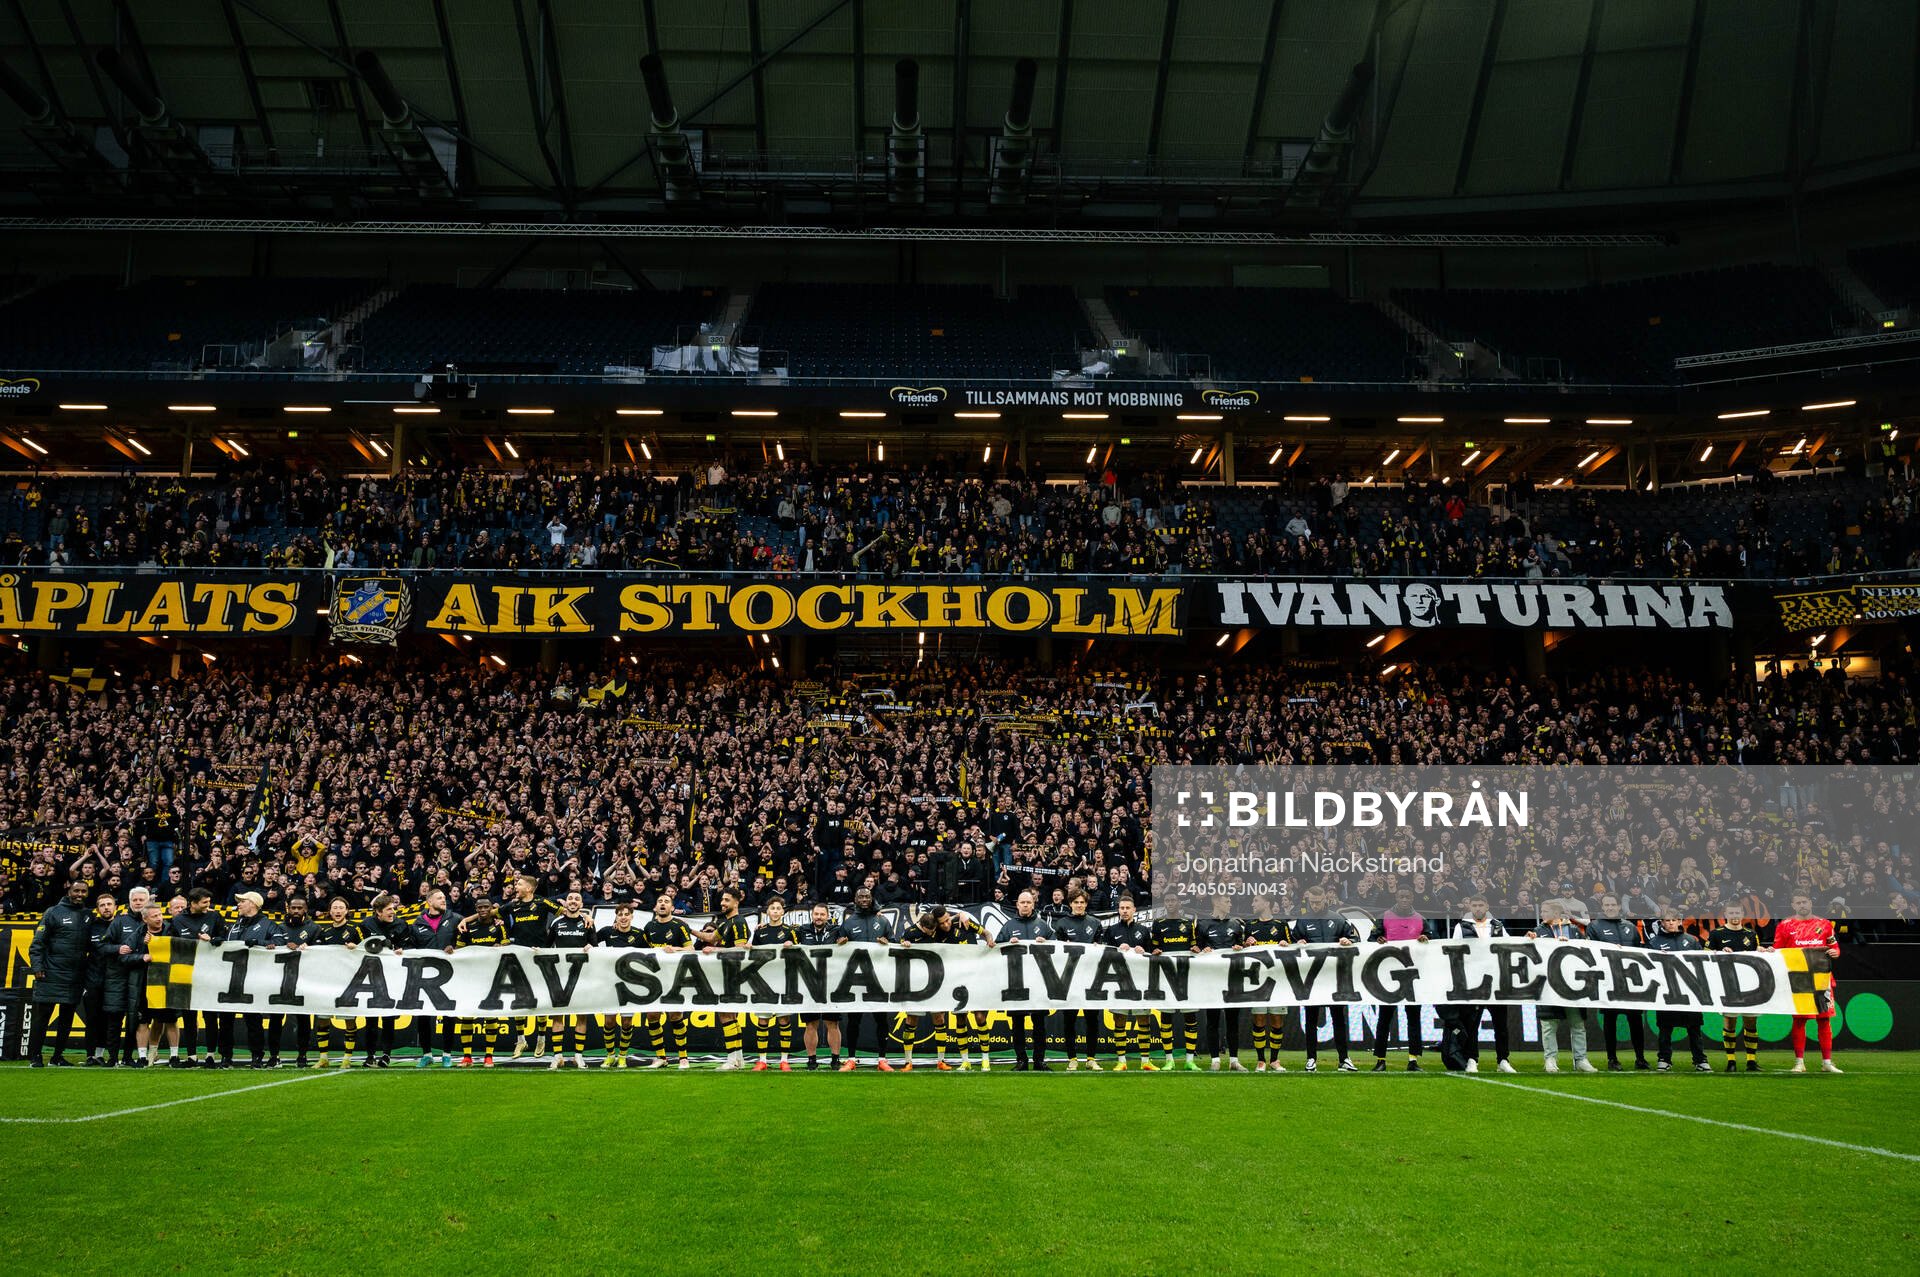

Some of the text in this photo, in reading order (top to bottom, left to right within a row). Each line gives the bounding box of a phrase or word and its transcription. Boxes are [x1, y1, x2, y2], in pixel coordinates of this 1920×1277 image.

[898, 391, 938, 402] friends
[966, 391, 1183, 406] TILLSAMMANS MOT MOBBNING
[1210, 394, 1250, 406] friends
[427, 583, 1184, 636] AIK STOCKHOLM
[1217, 582, 1734, 628] IVAN TURINA
[1779, 594, 1856, 613] PÄRA
[6, 841, 80, 854] INVICTUS
[515, 914, 540, 924] truecaller
[471, 936, 497, 944] truecaller
[1163, 936, 1188, 944] truecaller
[217, 937, 1777, 1012] 11 ÅR AV SAKNAD, IVAN EVIG LEGEND
[20, 1003, 33, 1056] SELECT
